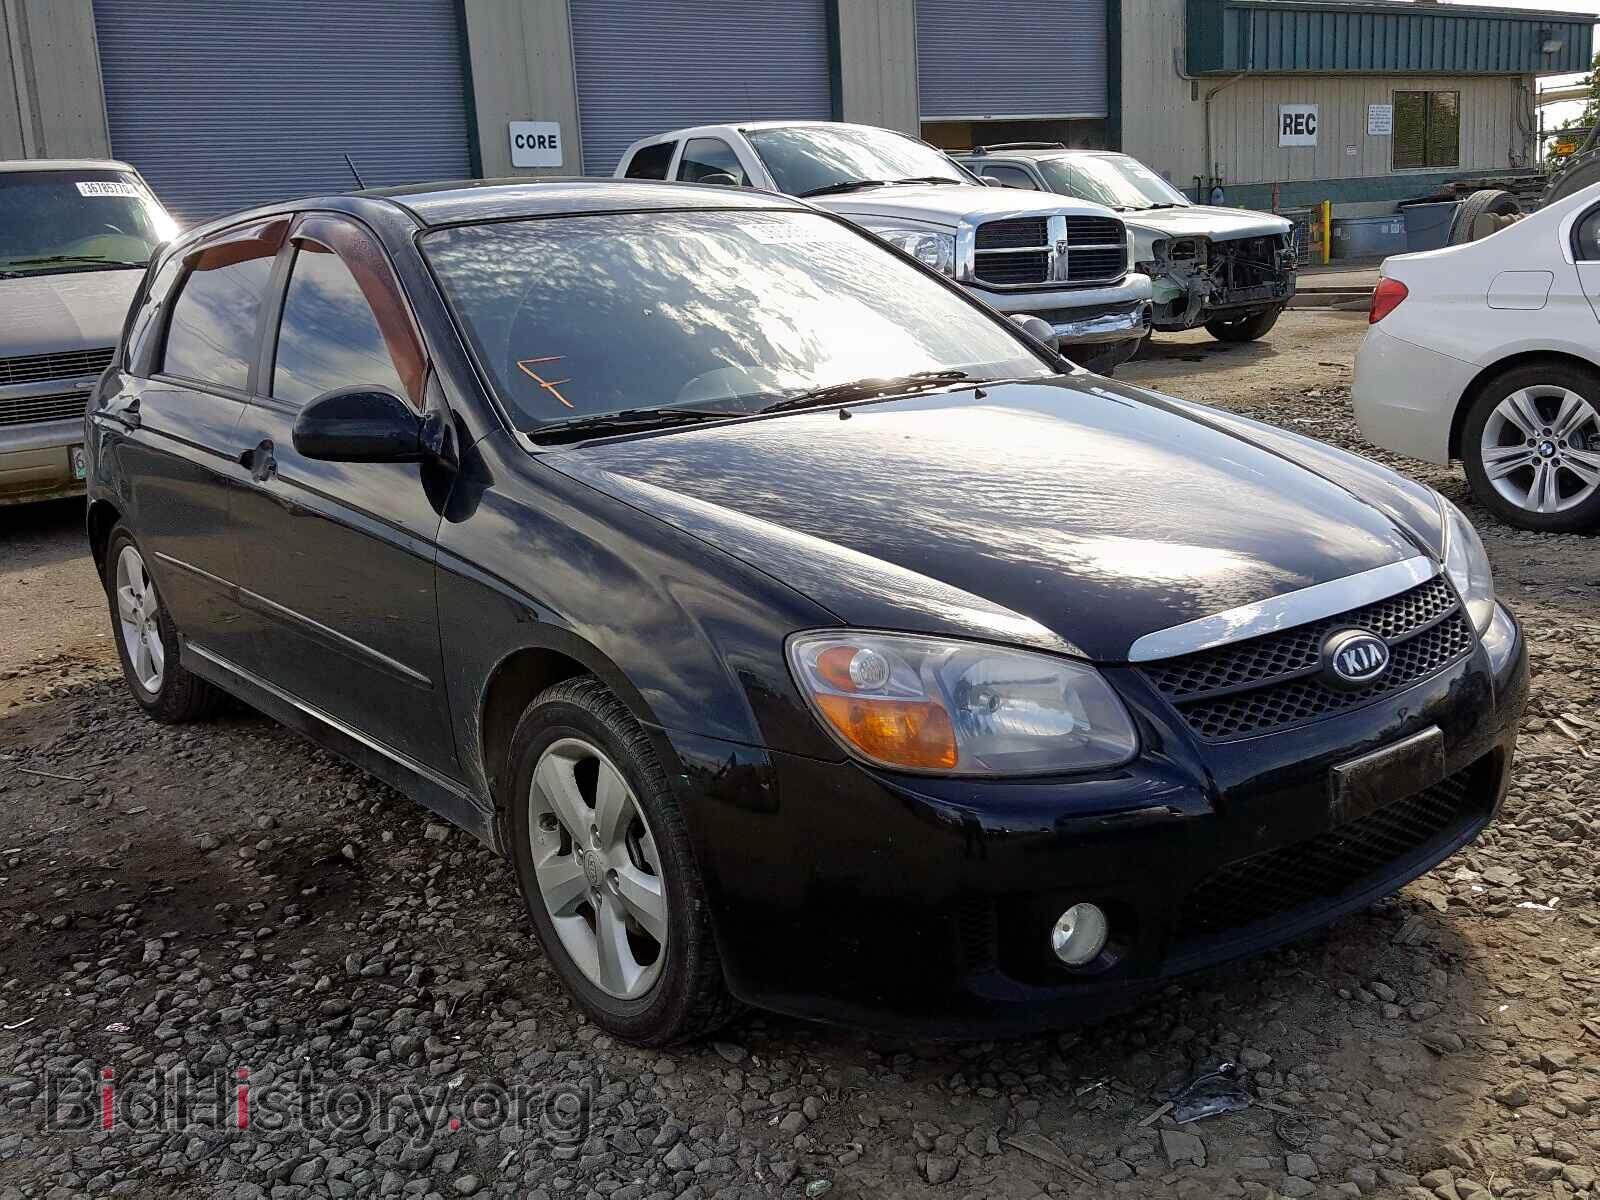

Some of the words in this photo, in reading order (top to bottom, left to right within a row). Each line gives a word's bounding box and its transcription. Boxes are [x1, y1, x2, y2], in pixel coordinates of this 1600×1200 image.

[1282, 112, 1316, 135] REC
[514, 133, 558, 149] CORE
[1342, 643, 1384, 674] KIA
